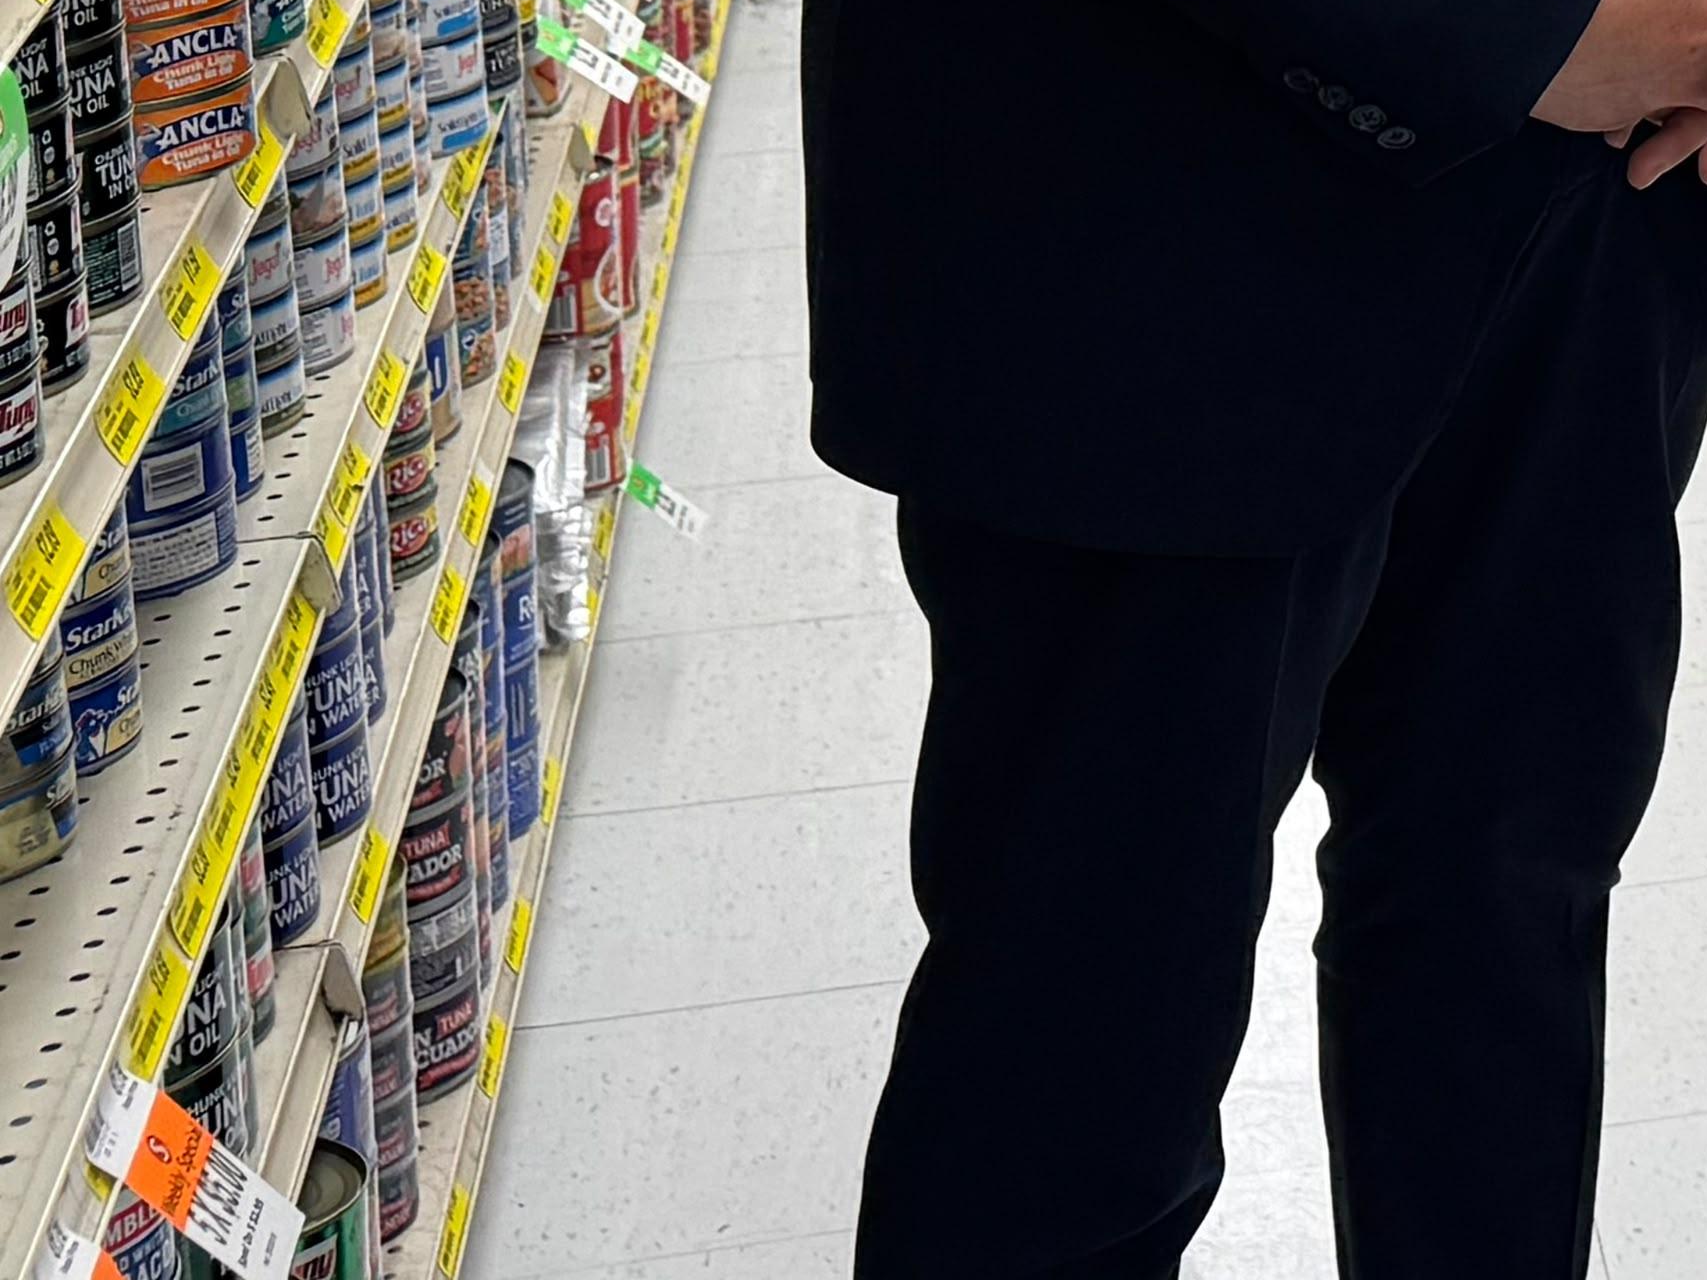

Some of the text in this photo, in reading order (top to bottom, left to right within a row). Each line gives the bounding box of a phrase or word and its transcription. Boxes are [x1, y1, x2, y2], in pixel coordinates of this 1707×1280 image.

[73, 6, 100, 28] OIL
[147, 24, 239, 64] ANCLA
[82, 98, 110, 115] OIL
[156, 105, 245, 147] ANCLA
